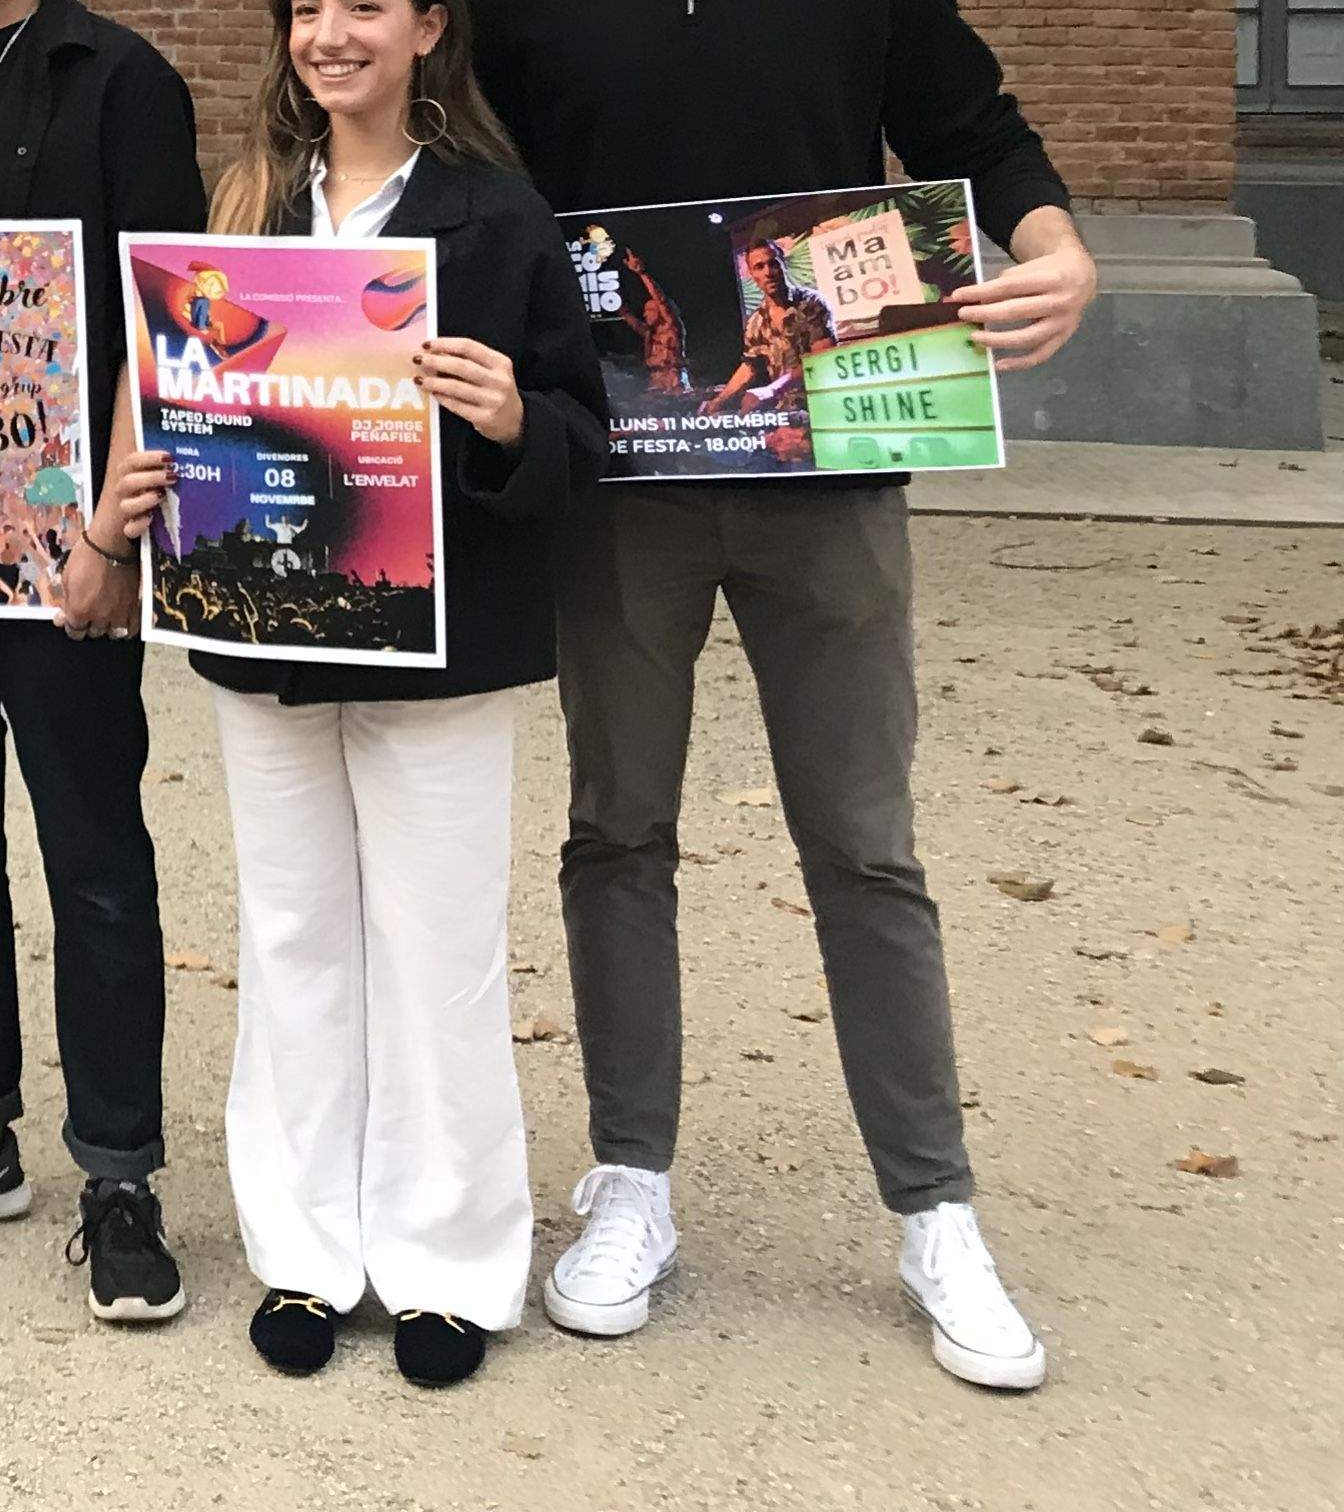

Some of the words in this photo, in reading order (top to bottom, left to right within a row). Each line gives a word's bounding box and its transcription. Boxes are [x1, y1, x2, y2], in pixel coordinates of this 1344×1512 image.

[239, 292, 252, 301] LA
[156, 333, 211, 369] LA
[834, 342, 918, 380] SERGI
[0, 376, 42, 399] grup
[157, 366, 425, 411] MARTINADA
[843, 389, 937, 423] SHINE
[161, 408, 203, 424] TAPEO
[206, 412, 253, 427] SOUND
[351, 419, 372, 431] DJ
[375, 419, 425, 432] JORGE
[663, 417, 676, 430] 11
[682, 412, 790, 431] NOVEMBRE
[161, 419, 214, 435] SYSTEM
[175, 446, 200, 457] HORA
[633, 439, 691, 454] FESTA
[705, 436, 767, 453] 18.00H
[256, 451, 309, 463] DIVENDRES
[358, 455, 404, 466] UBICACIÓ
[264, 468, 296, 488] 08
[343, 473, 419, 488] L'ENVELAT
